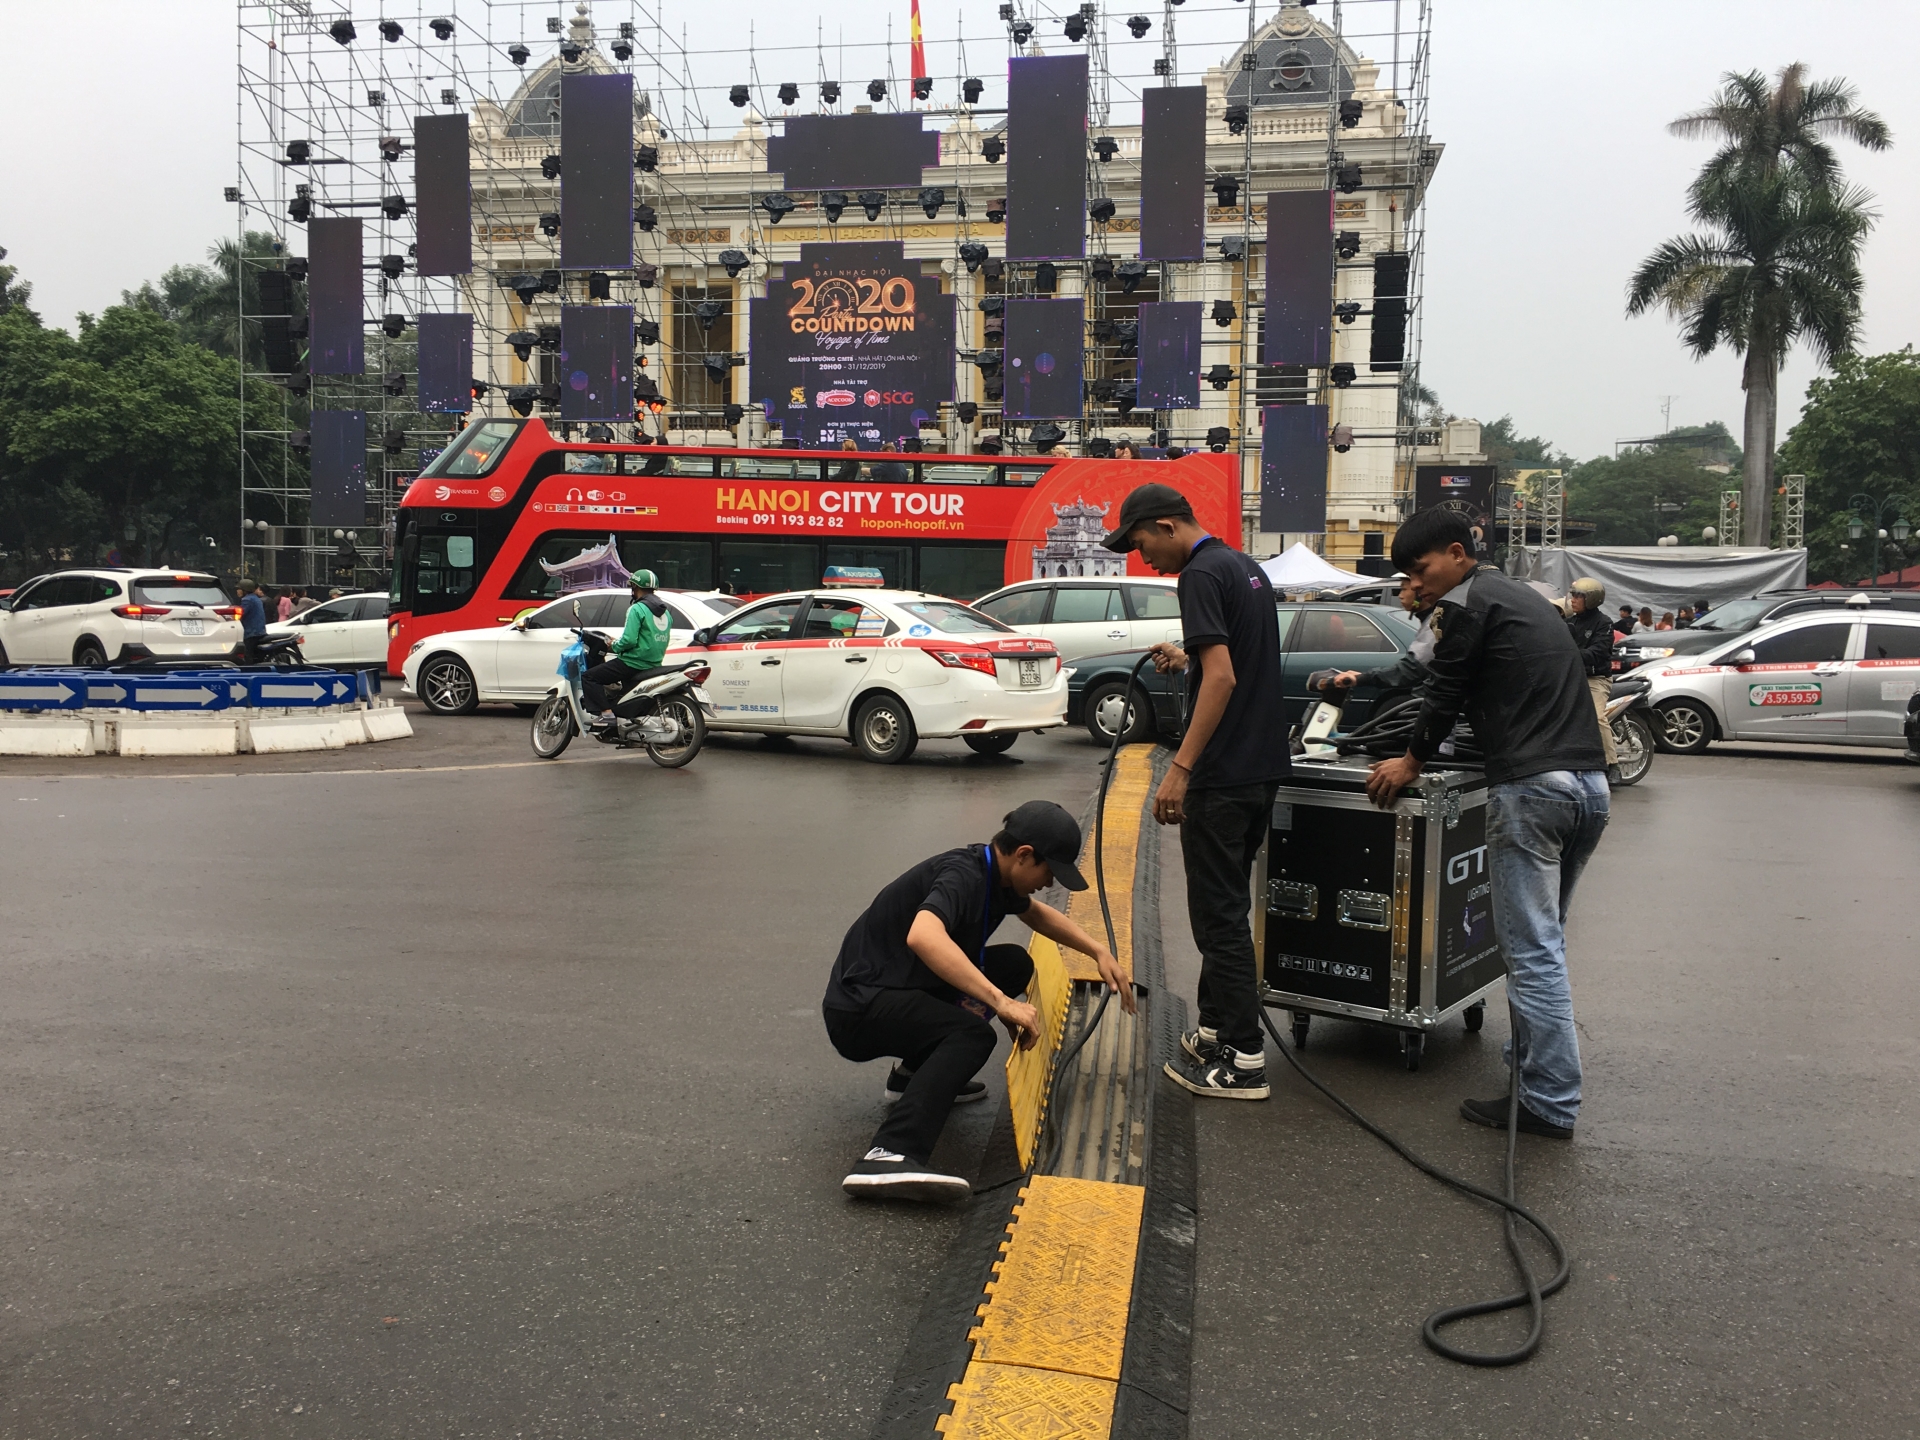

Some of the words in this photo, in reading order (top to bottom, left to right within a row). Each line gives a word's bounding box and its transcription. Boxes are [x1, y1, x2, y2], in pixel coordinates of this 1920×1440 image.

[819, 305, 855, 321] Party
[791, 316, 915, 333] COUNTDOWN
[815, 331, 852, 350] Voyage
[854, 331, 868, 349] of
[866, 331, 890, 345] Time
[848, 363, 886, 371] 31/12/2019
[882, 391, 914, 405] SCG
[716, 487, 810, 512] HANOI
[818, 490, 889, 514] CITY
[890, 492, 964, 516] TOUR
[716, 515, 748, 525] Booking
[752, 513, 776, 525] 091
[781, 514, 804, 526] 193
[808, 515, 825, 527] 82
[827, 516, 844, 528] 82
[860, 517, 965, 532] hopon-hopoff.vn
[1766, 693, 1819, 704] 3.59.59.59
